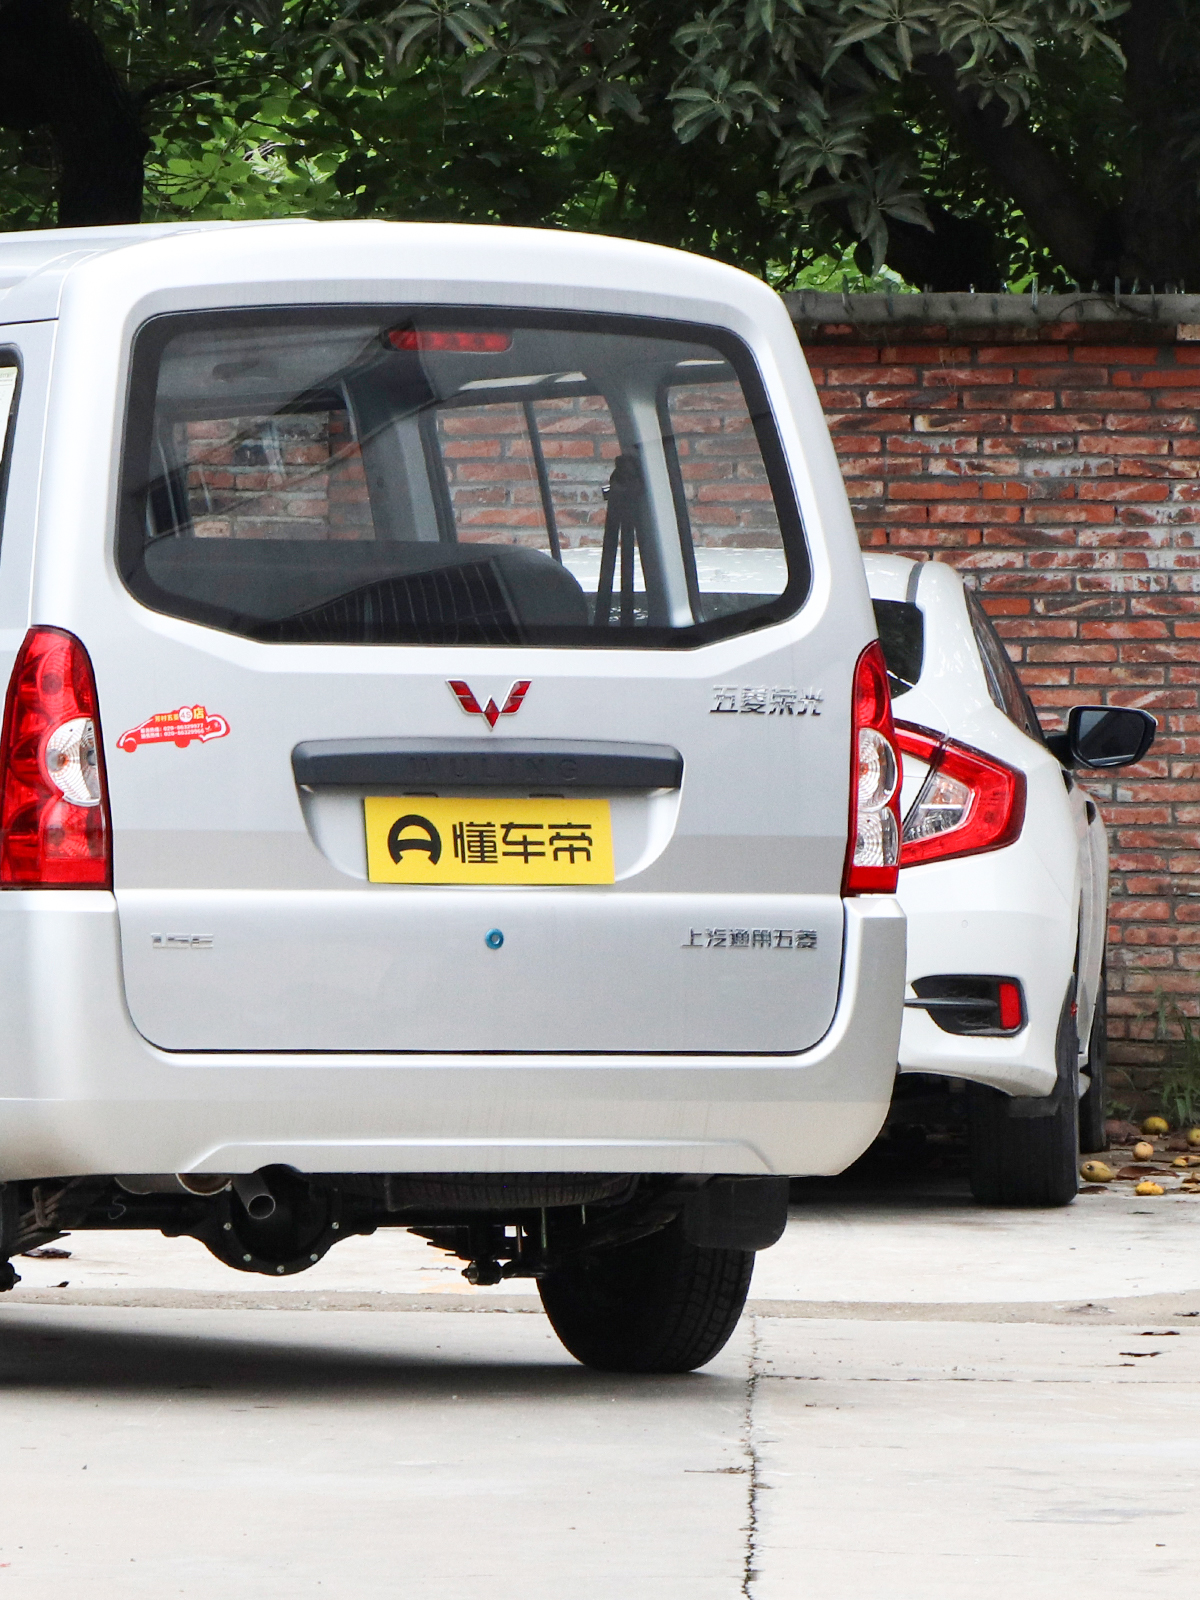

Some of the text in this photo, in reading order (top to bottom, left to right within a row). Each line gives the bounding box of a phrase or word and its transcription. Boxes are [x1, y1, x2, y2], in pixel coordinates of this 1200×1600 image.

[709, 685, 824, 715] 五菱荣光
[409, 756, 578, 781] WULING
[452, 821, 593, 864] 懂车帝
[682, 927, 818, 949] 上汽通用五菱
